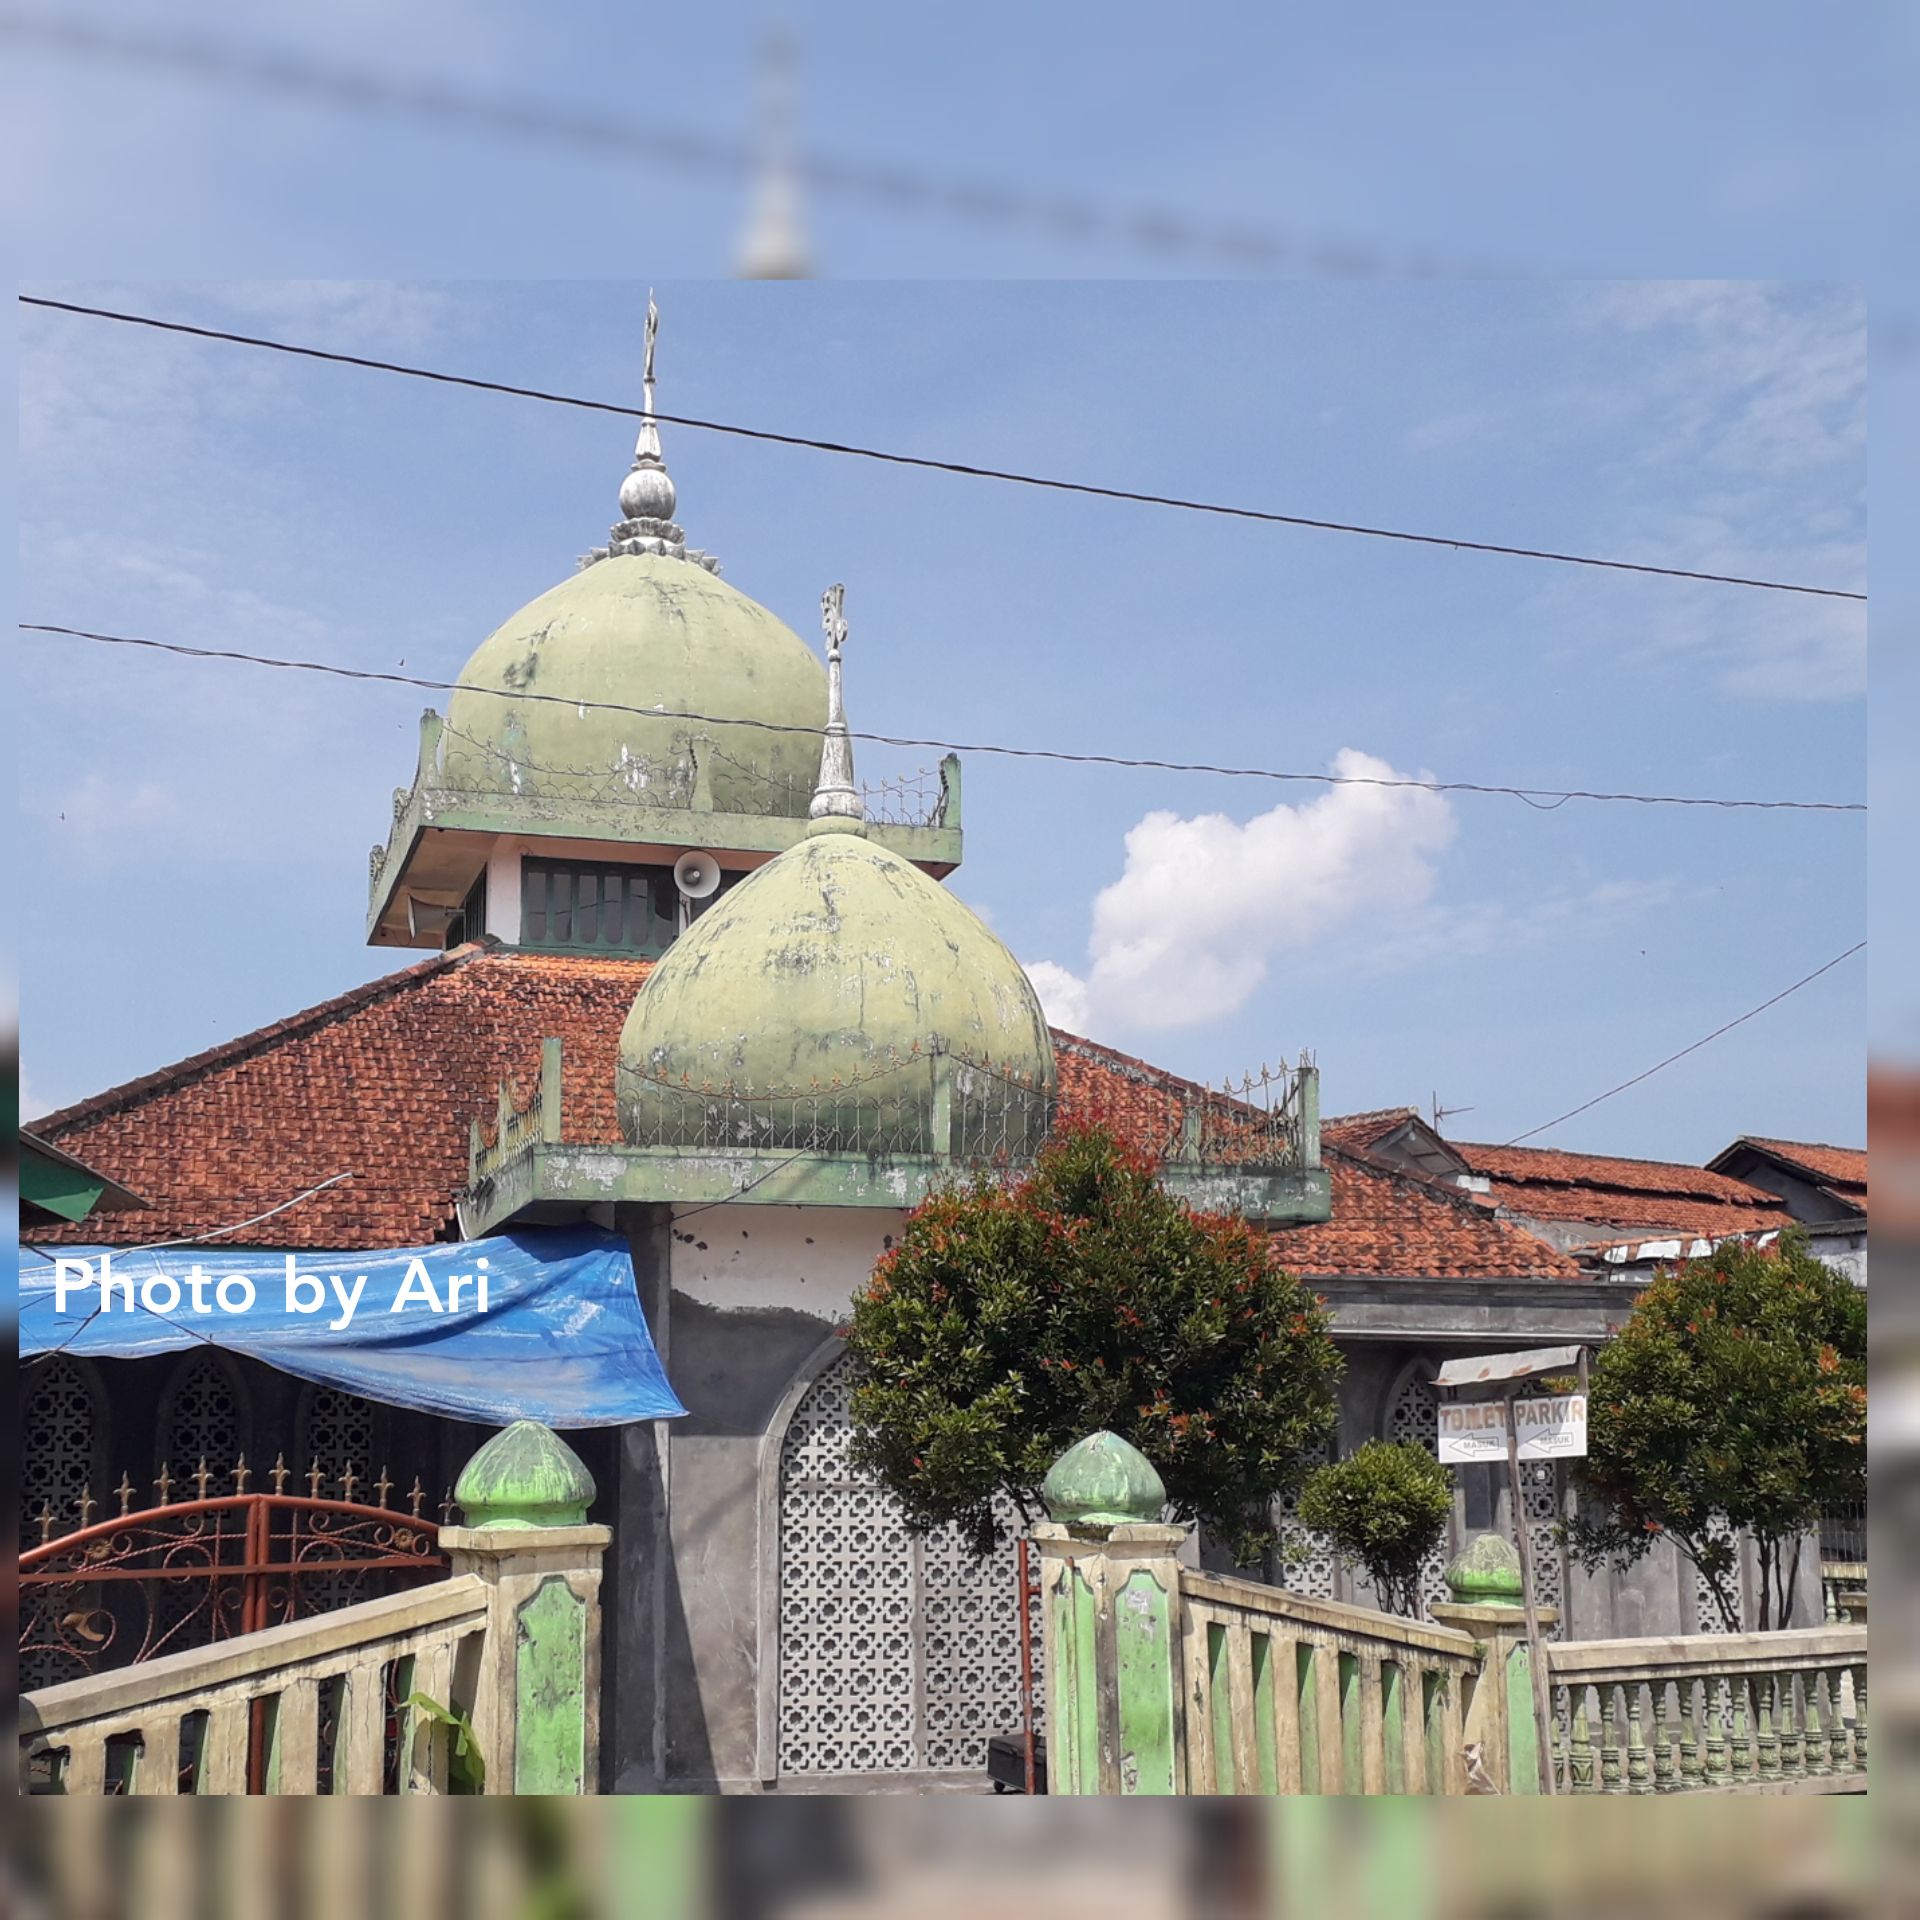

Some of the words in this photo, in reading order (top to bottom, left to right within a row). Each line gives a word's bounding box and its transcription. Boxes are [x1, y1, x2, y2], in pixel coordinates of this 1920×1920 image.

[1515, 1400, 1585, 1426] PARKIR
[1463, 1439, 1496, 1449] MASUK
[1539, 1435, 1571, 1445] MASUK
